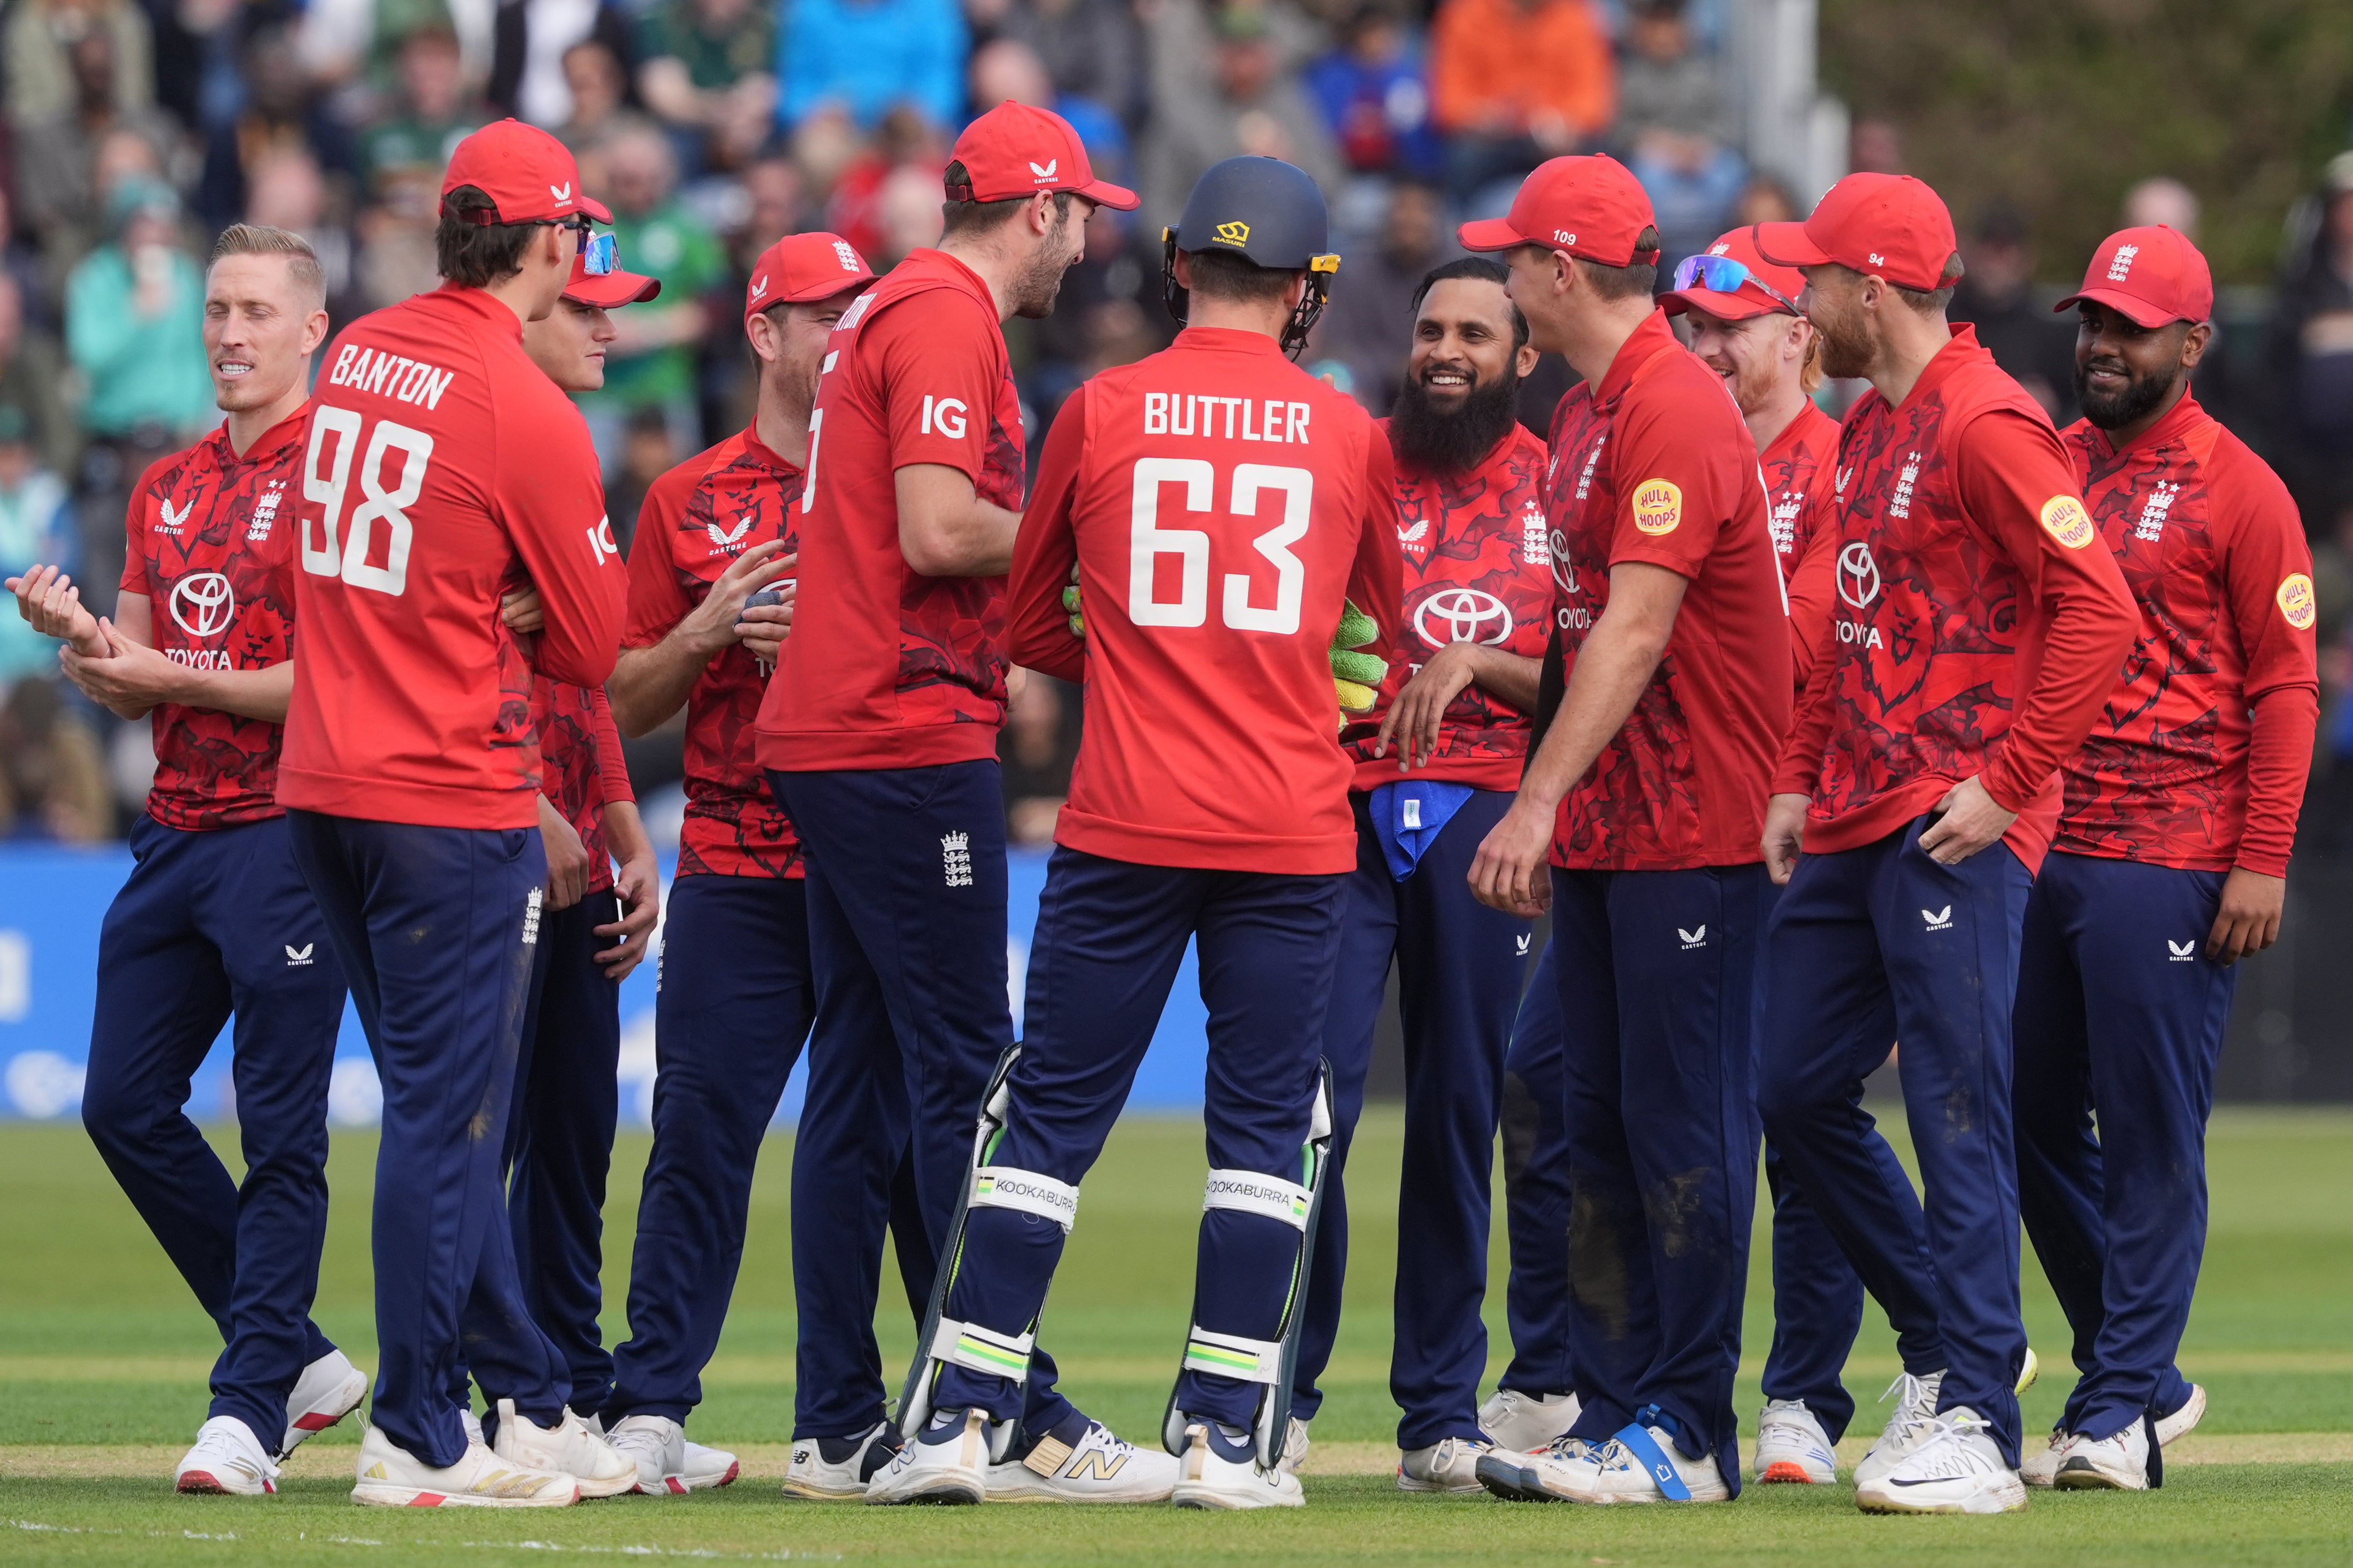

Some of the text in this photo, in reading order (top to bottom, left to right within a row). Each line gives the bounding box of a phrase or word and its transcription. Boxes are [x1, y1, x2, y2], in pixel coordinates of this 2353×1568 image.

[1212, 236, 1245, 248] MASURI
[1553, 229, 1576, 245] 109
[1868, 252, 1884, 267] 94
[329, 344, 454, 411] BANTON
[921, 394, 968, 439] IG
[1144, 392, 1310, 444] BUTTLER
[301, 404, 434, 596] 98
[1640, 489, 1672, 508] HULA
[1639, 507, 1676, 527] HOOPS
[2049, 504, 2077, 528] HULA
[2058, 516, 2088, 542] HOOPS
[709, 541, 747, 556] CASTORE
[1128, 457, 1314, 635] 63
[1401, 542, 1425, 554] TORE
[2285, 582, 2307, 604] HULA
[2287, 598, 2312, 622] HOOPS
[165, 648, 232, 671] TOYOTA
